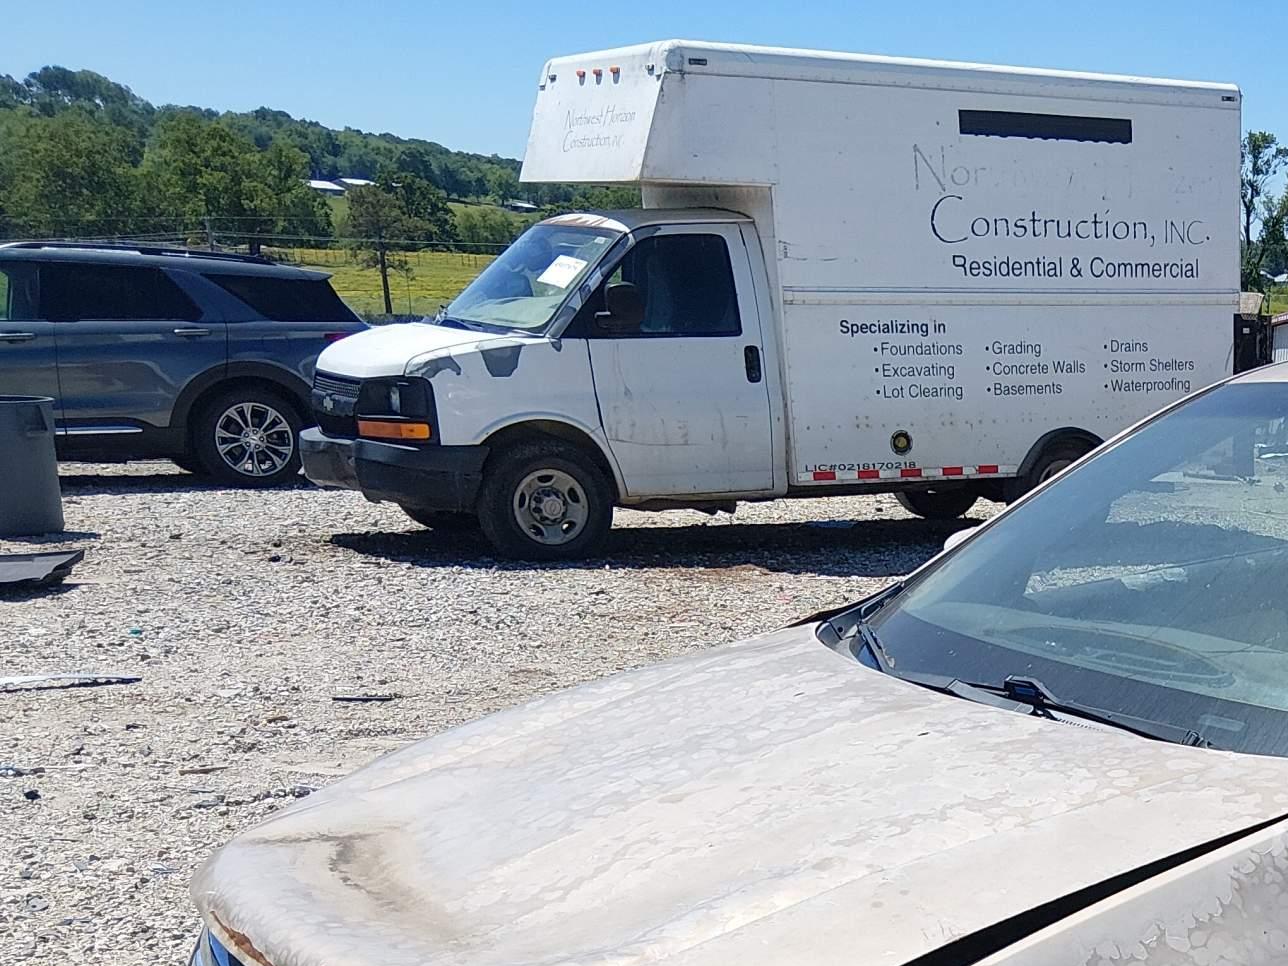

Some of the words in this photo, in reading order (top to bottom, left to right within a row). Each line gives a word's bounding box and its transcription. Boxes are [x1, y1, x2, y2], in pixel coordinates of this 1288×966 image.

[931, 195, 1156, 247] Construction,
[1164, 219, 1211, 245] INC.
[952, 254, 1063, 279] Residential
[1069, 257, 1084, 279] &
[1089, 257, 1200, 279] Commercial
[839, 319, 930, 338] Specializing
[933, 320, 946, 334] in
[880, 341, 963, 357] Foundations
[991, 340, 1042, 358] Grading
[1110, 339, 1149, 354] Drains
[882, 363, 956, 380] Excavating
[992, 361, 1049, 376] Concrete
[1052, 360, 1086, 375] Walls
[1110, 358, 1146, 373] Storm
[1149, 357, 1195, 372] Shelters
[882, 385, 905, 400] Lot
[908, 383, 963, 401] Clearing
[993, 381, 1063, 397] Basements
[1110, 377, 1191, 395] Waterproofing
